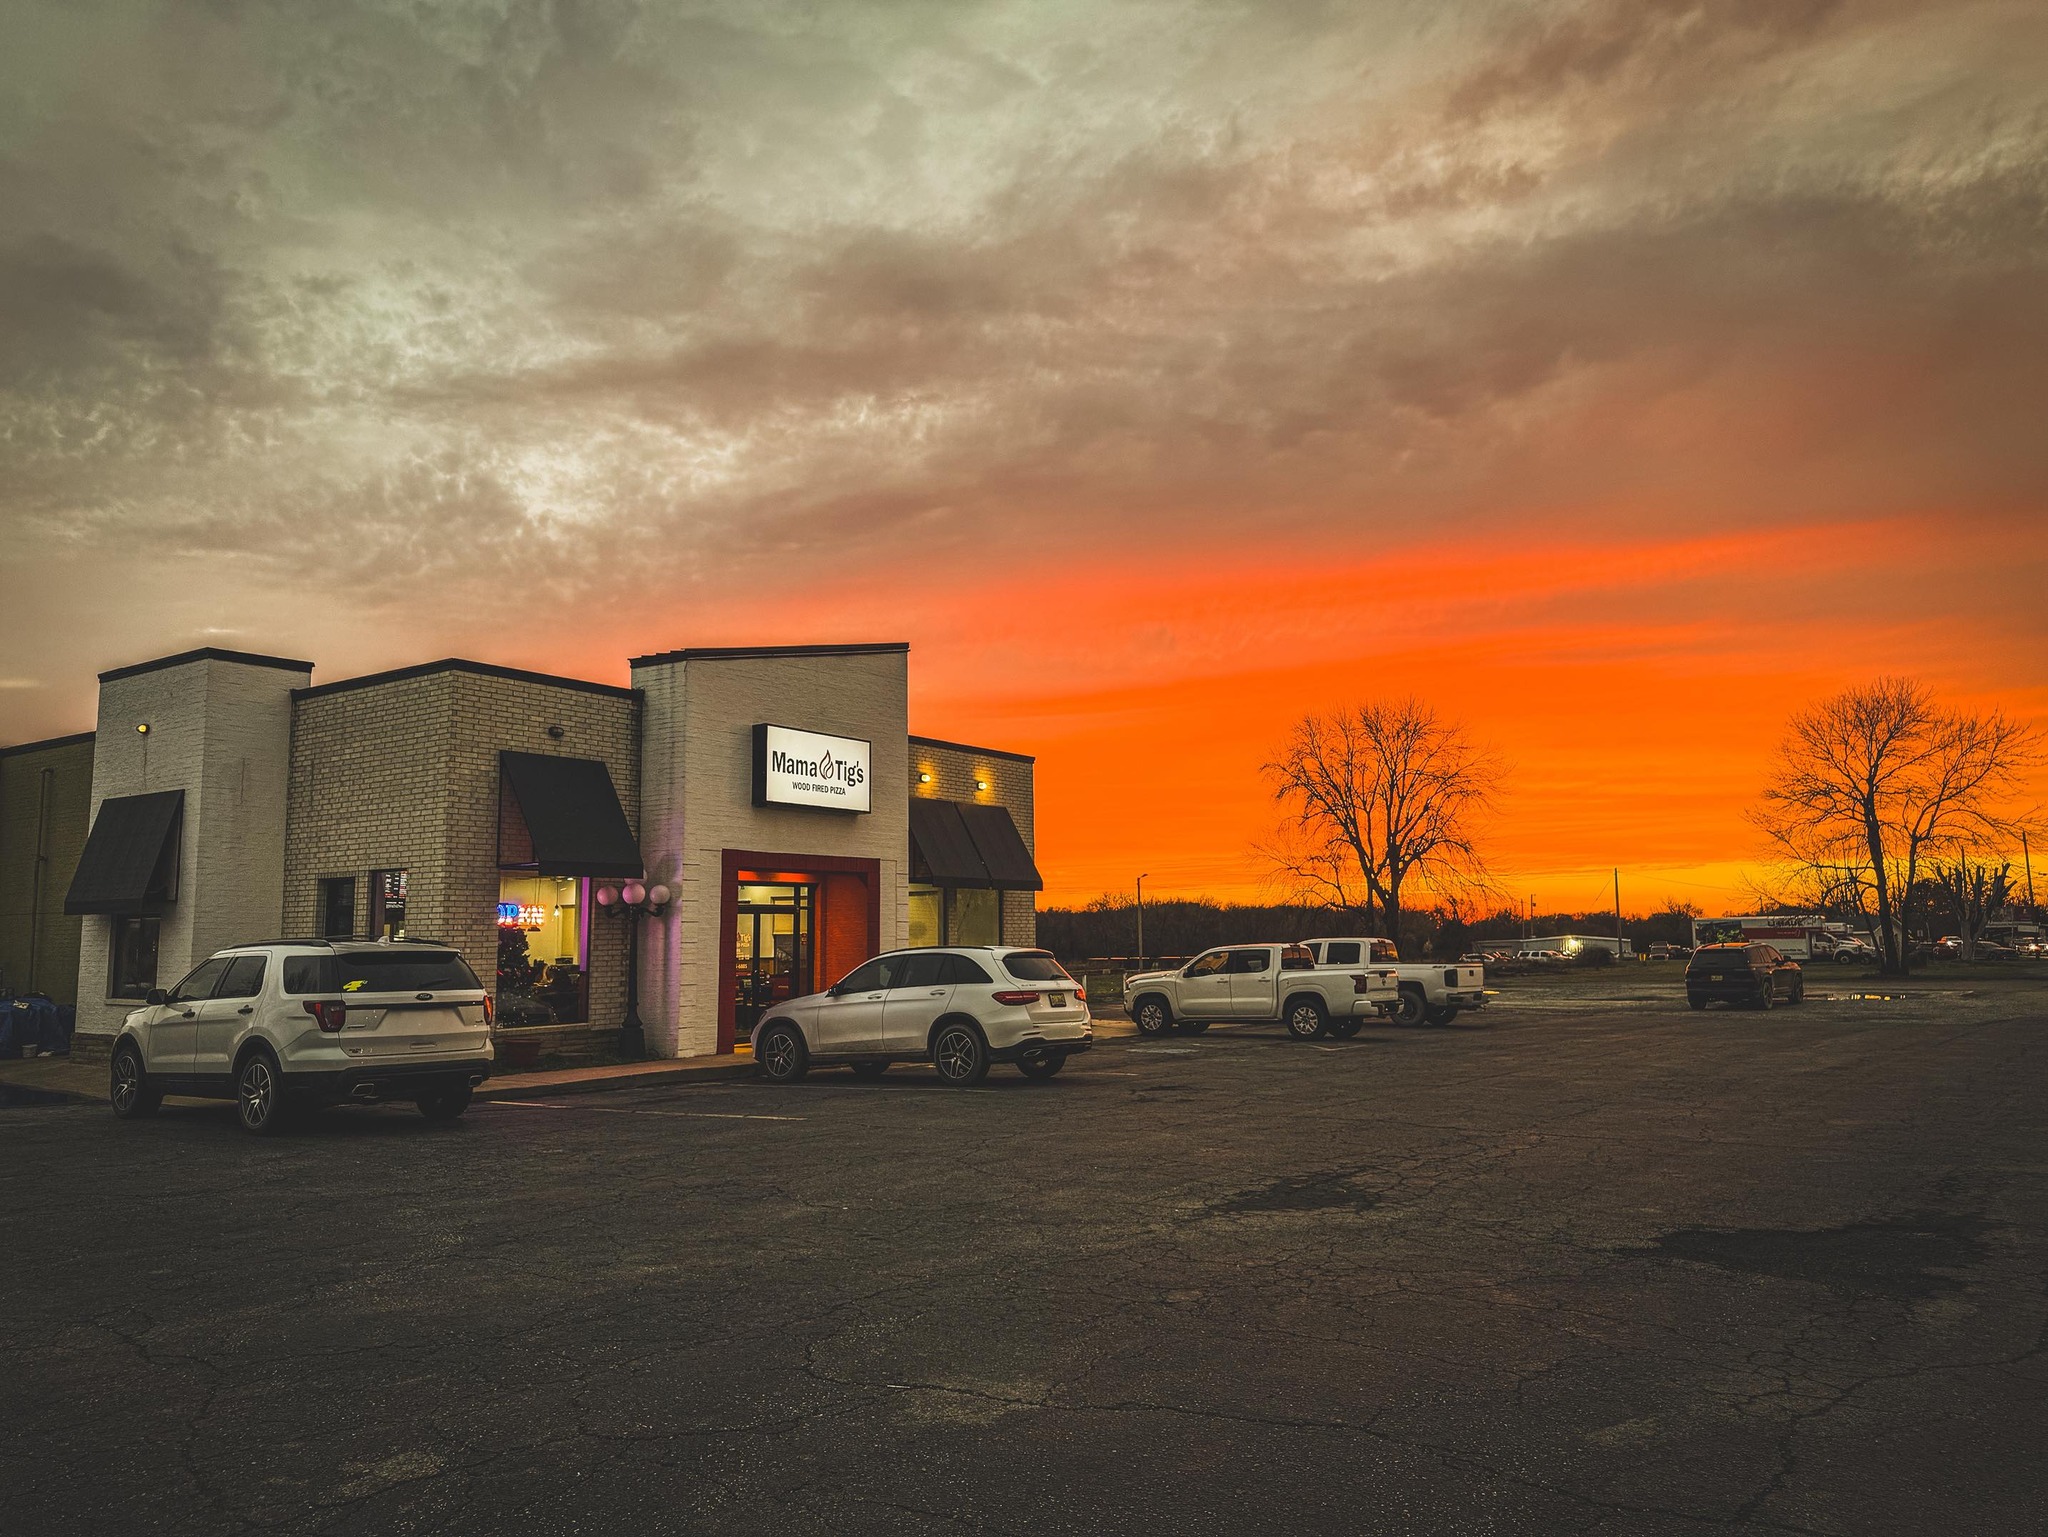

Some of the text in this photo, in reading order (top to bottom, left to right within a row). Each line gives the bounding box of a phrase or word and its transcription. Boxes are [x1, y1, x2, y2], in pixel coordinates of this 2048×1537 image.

[772, 750, 864, 787] Mama Tig's
[792, 781, 846, 795] WOOD FIRED PIZZA
